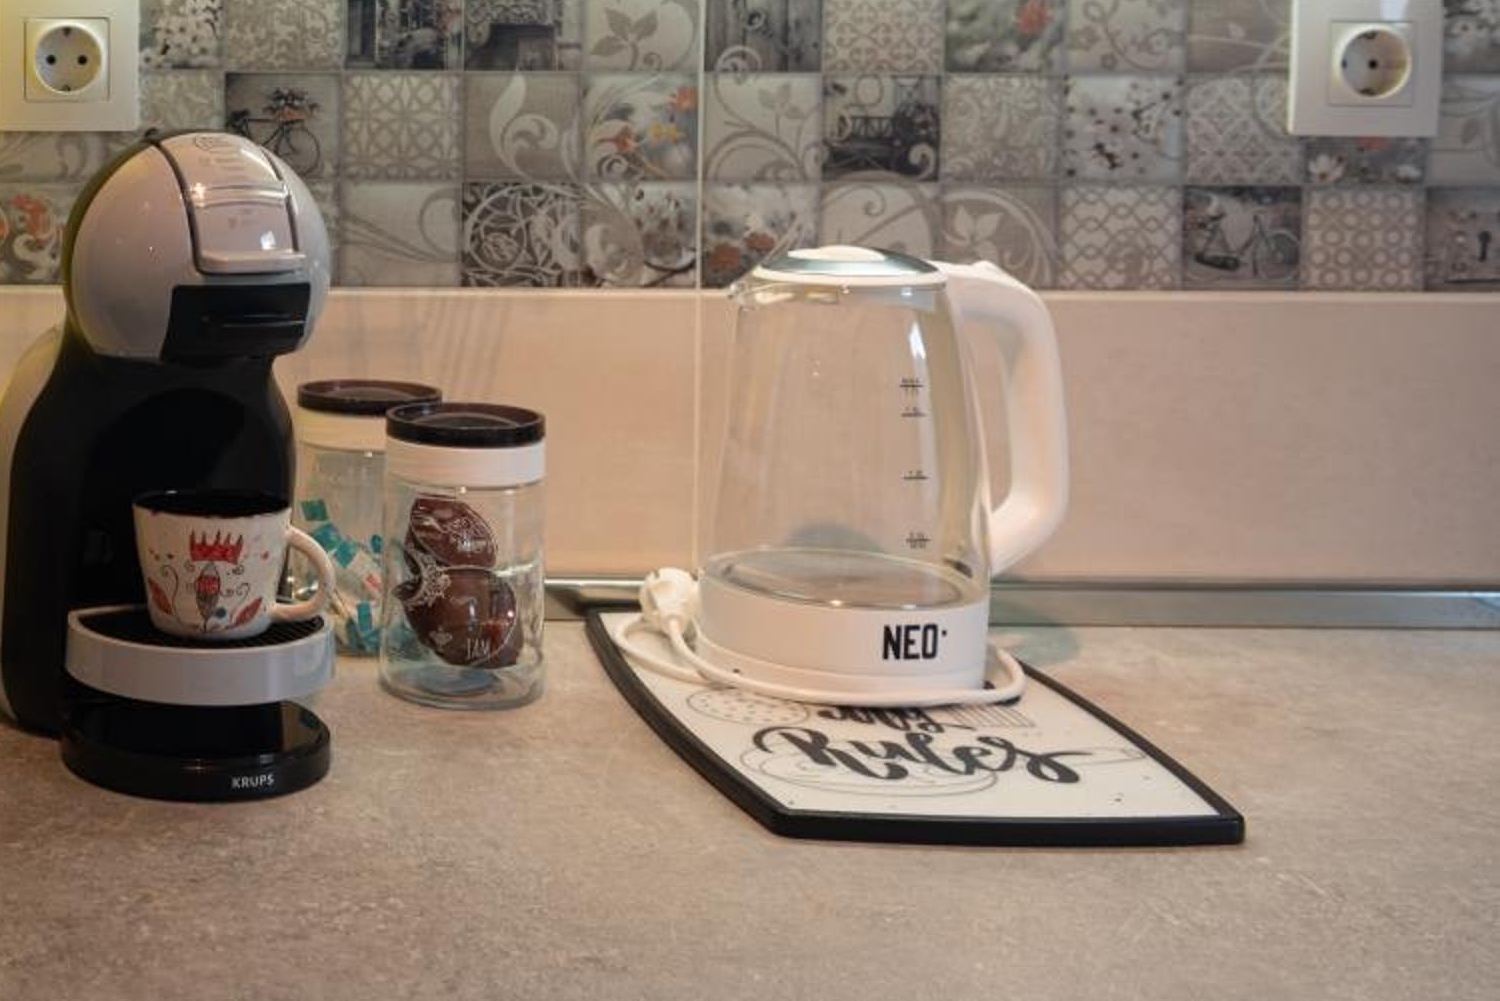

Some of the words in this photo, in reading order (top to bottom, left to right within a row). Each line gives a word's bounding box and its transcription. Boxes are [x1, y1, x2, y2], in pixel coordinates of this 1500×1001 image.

[883, 624, 938, 660] NEO
[753, 726, 1091, 784] Rules
[231, 774, 275, 790] KRUPS
